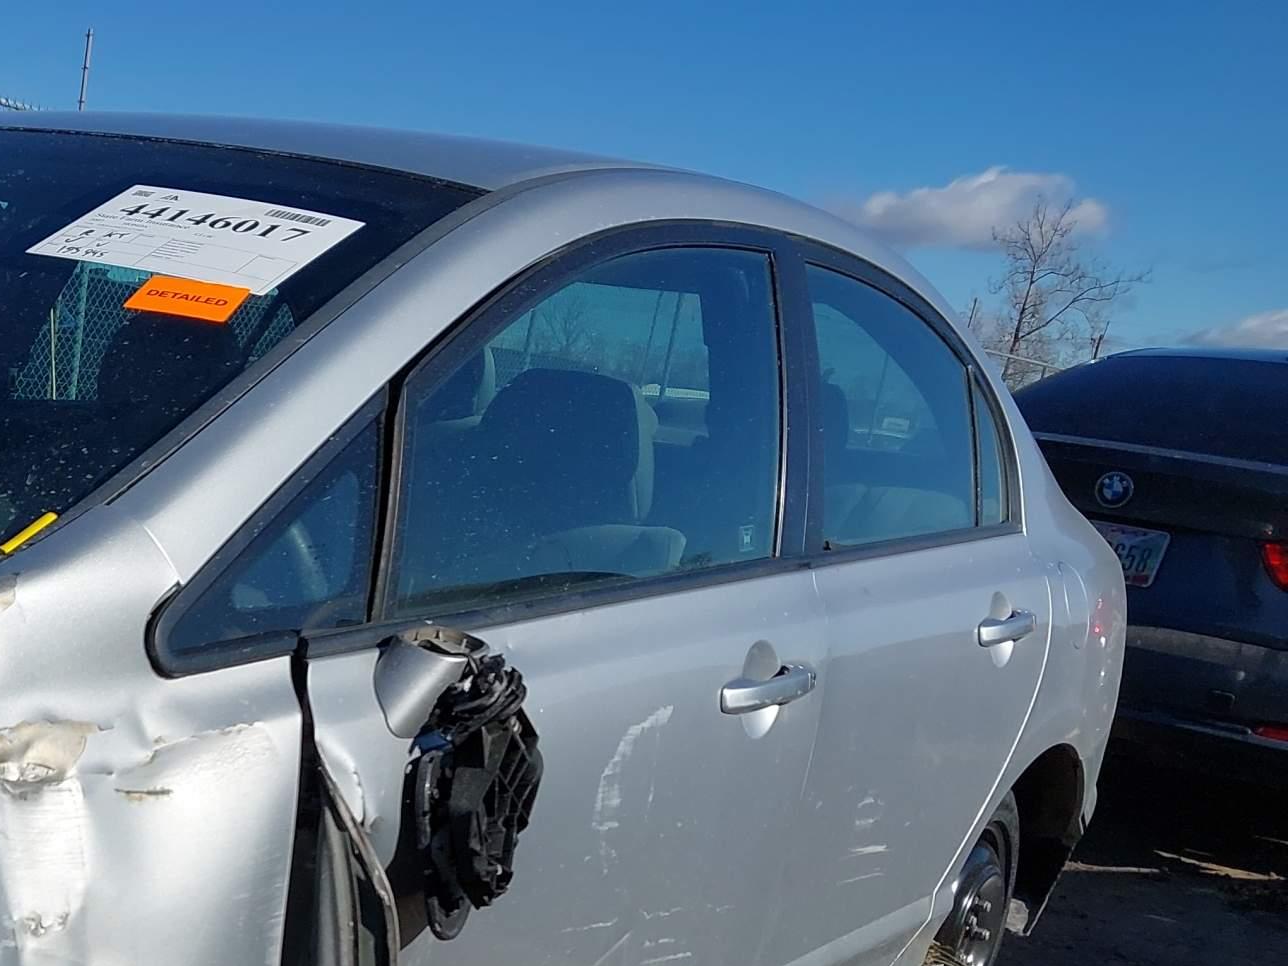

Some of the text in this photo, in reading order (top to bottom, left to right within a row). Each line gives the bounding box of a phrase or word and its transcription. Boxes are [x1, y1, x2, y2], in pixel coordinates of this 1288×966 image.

[120, 203, 312, 242] 44146017
[146, 289, 229, 307] DETAILED
[1108, 541, 1153, 573] 658
